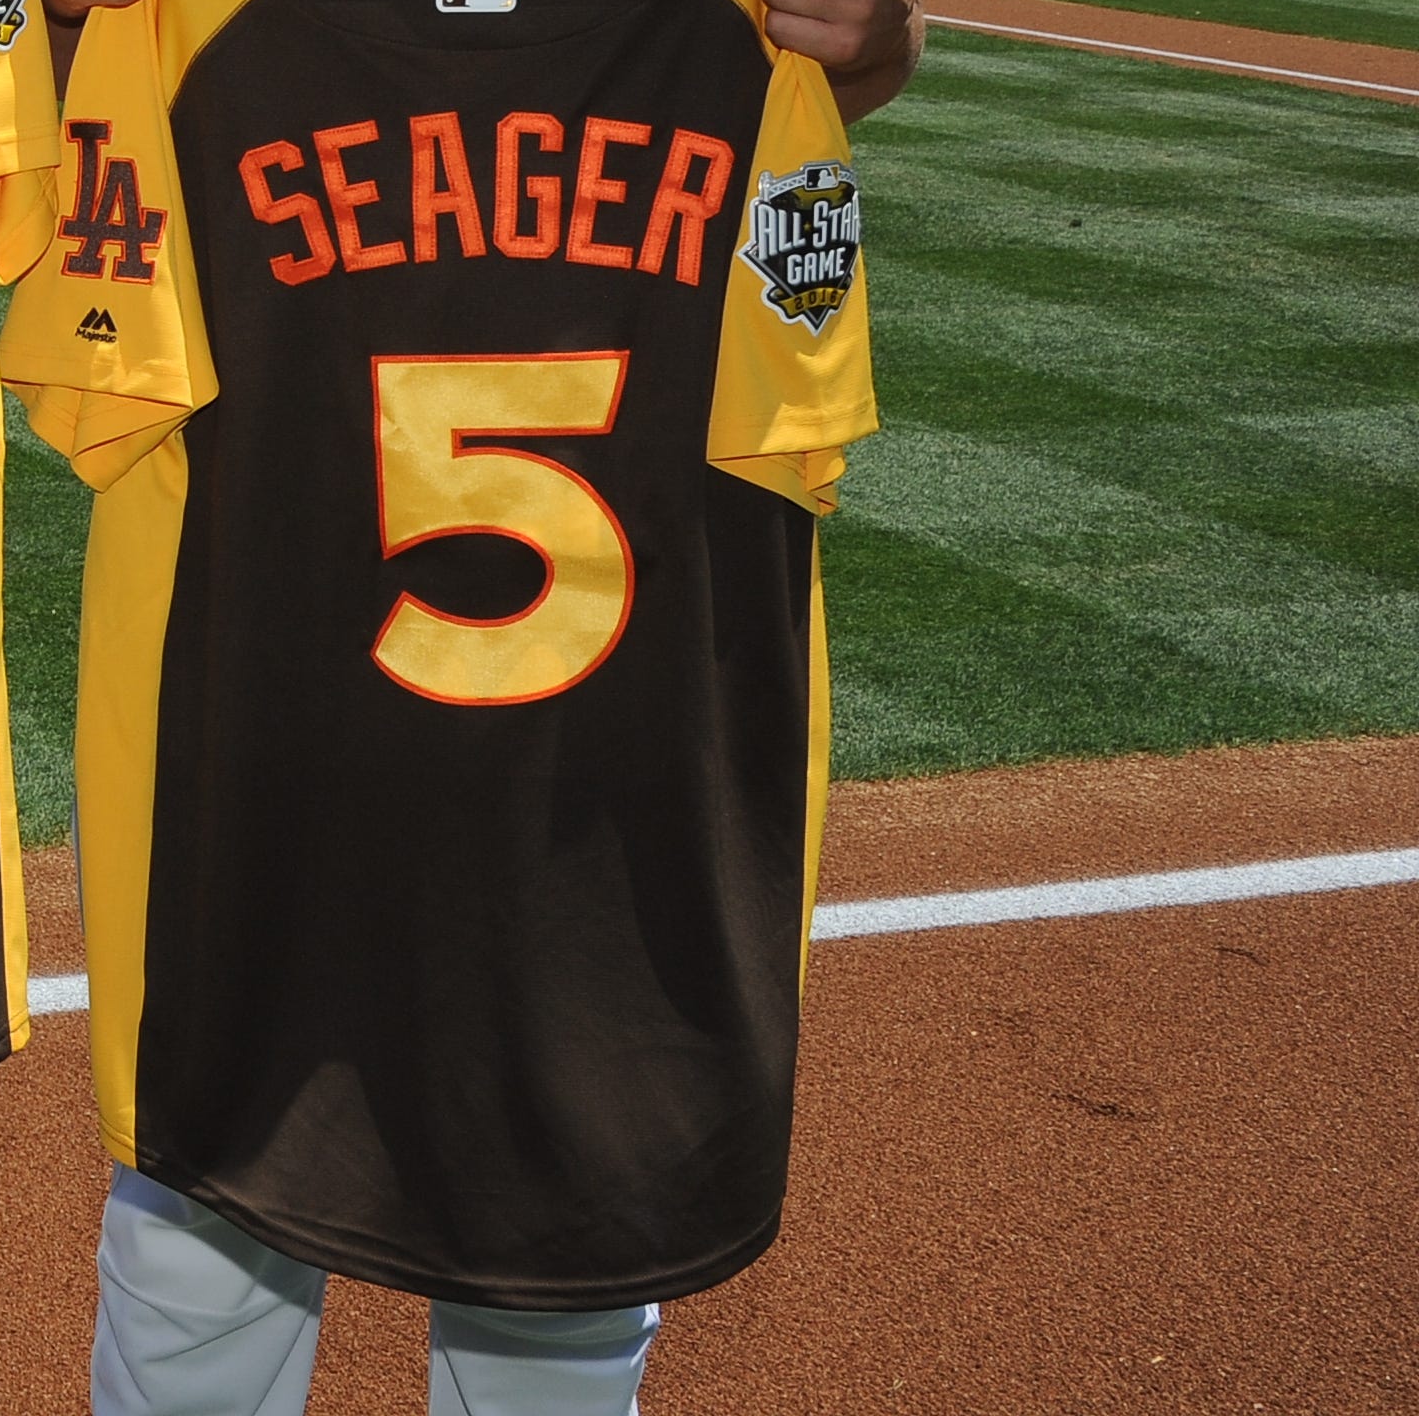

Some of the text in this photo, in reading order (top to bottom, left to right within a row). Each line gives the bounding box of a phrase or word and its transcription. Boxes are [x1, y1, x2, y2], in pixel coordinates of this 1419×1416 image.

[57, 118, 168, 286] LA
[238, 111, 735, 287] SEAGER
[756, 190, 861, 261] ALL STAR
[787, 246, 847, 285] GAME
[793, 290, 839, 311] 2016
[75, 327, 117, 344] Majestic
[370, 350, 635, 707] 5
